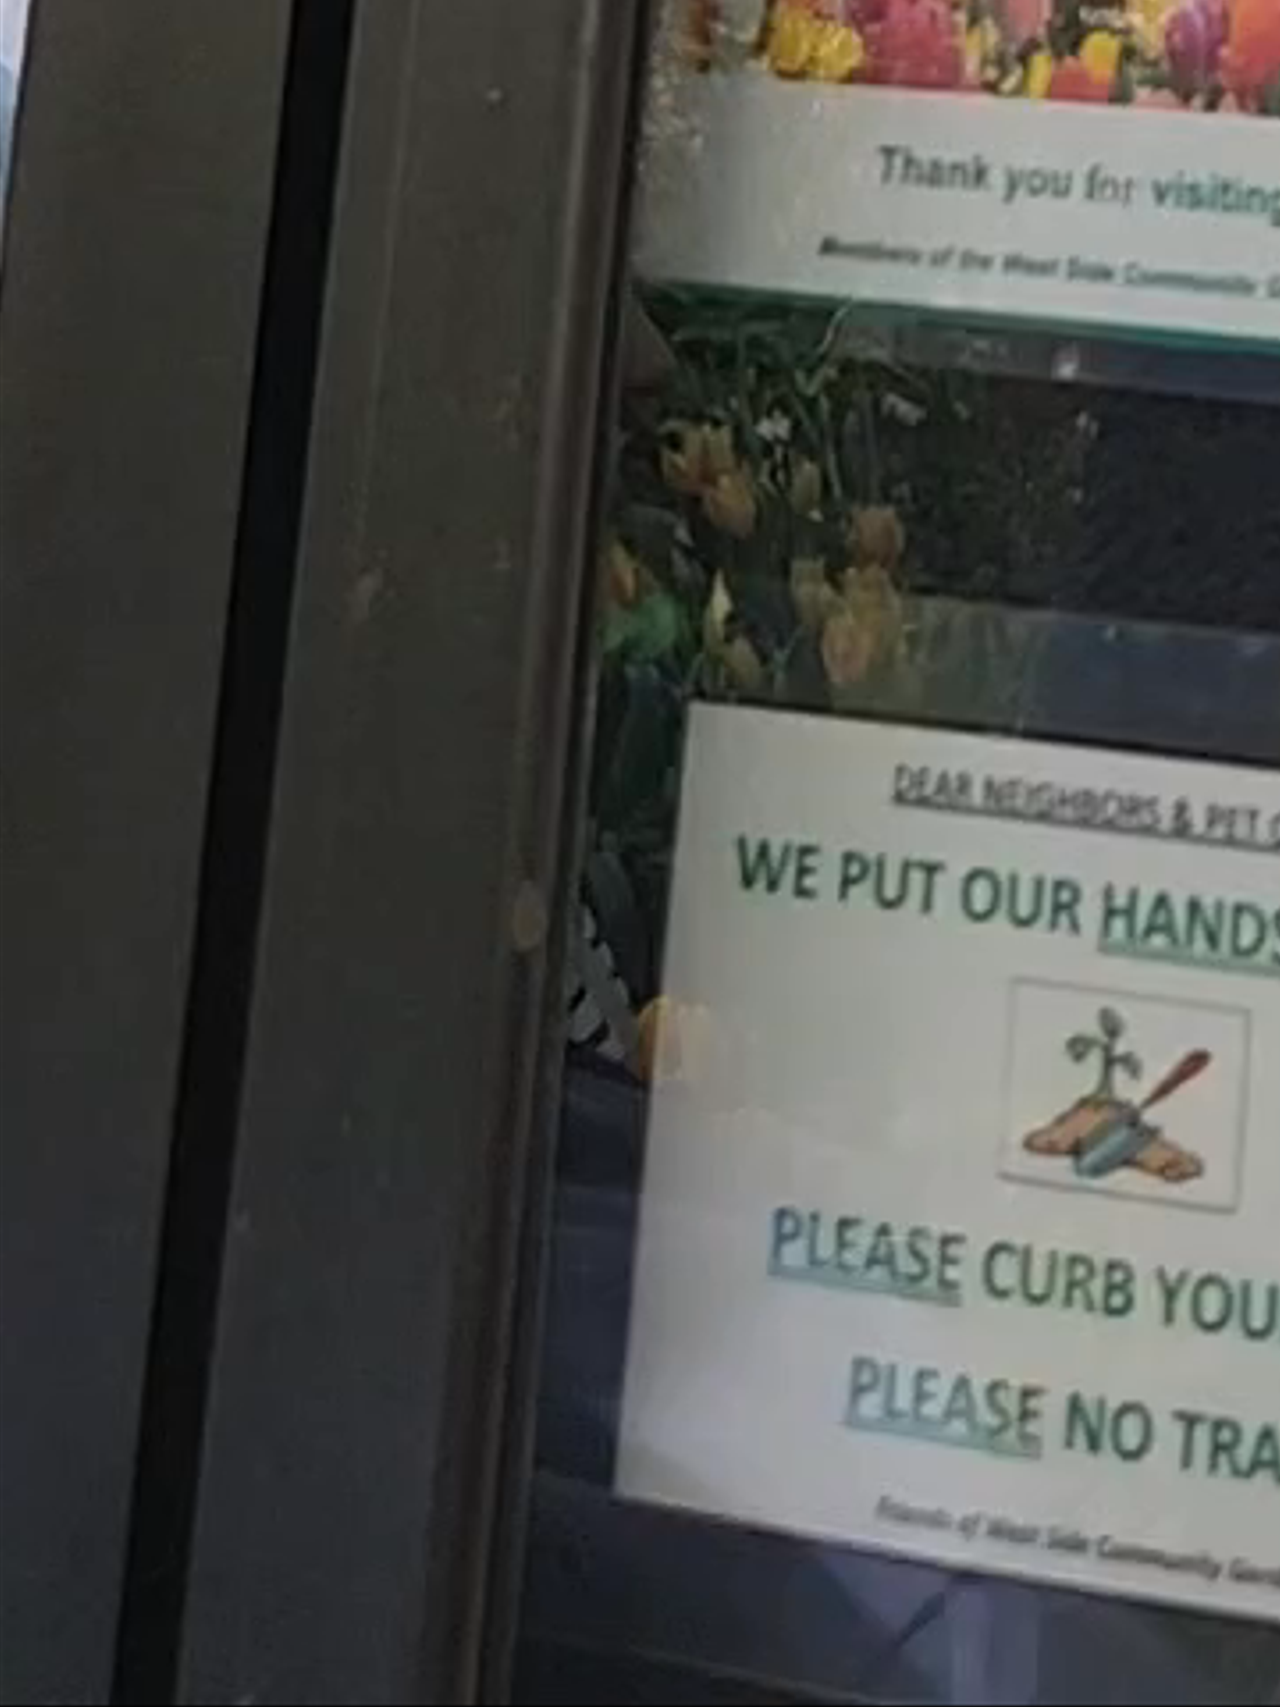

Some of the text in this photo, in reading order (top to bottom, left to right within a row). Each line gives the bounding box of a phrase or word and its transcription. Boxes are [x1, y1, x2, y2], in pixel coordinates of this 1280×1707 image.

[876, 145, 991, 193] Thank
[1002, 161, 1074, 205] you
[1083, 162, 1136, 206] for
[893, 765, 972, 805] DEAR
[983, 775, 1161, 832] NEIGHBORS
[1170, 796, 1195, 838] &
[1204, 802, 1261, 847] PET
[732, 833, 820, 900] WE
[837, 847, 947, 917] PUT
[959, 864, 1084, 936] OUR
[771, 1206, 965, 1294] PLEASE
[981, 1241, 1136, 1320] CURB
[847, 1355, 1046, 1450] PLEASE
[1064, 1391, 1154, 1463] NO
